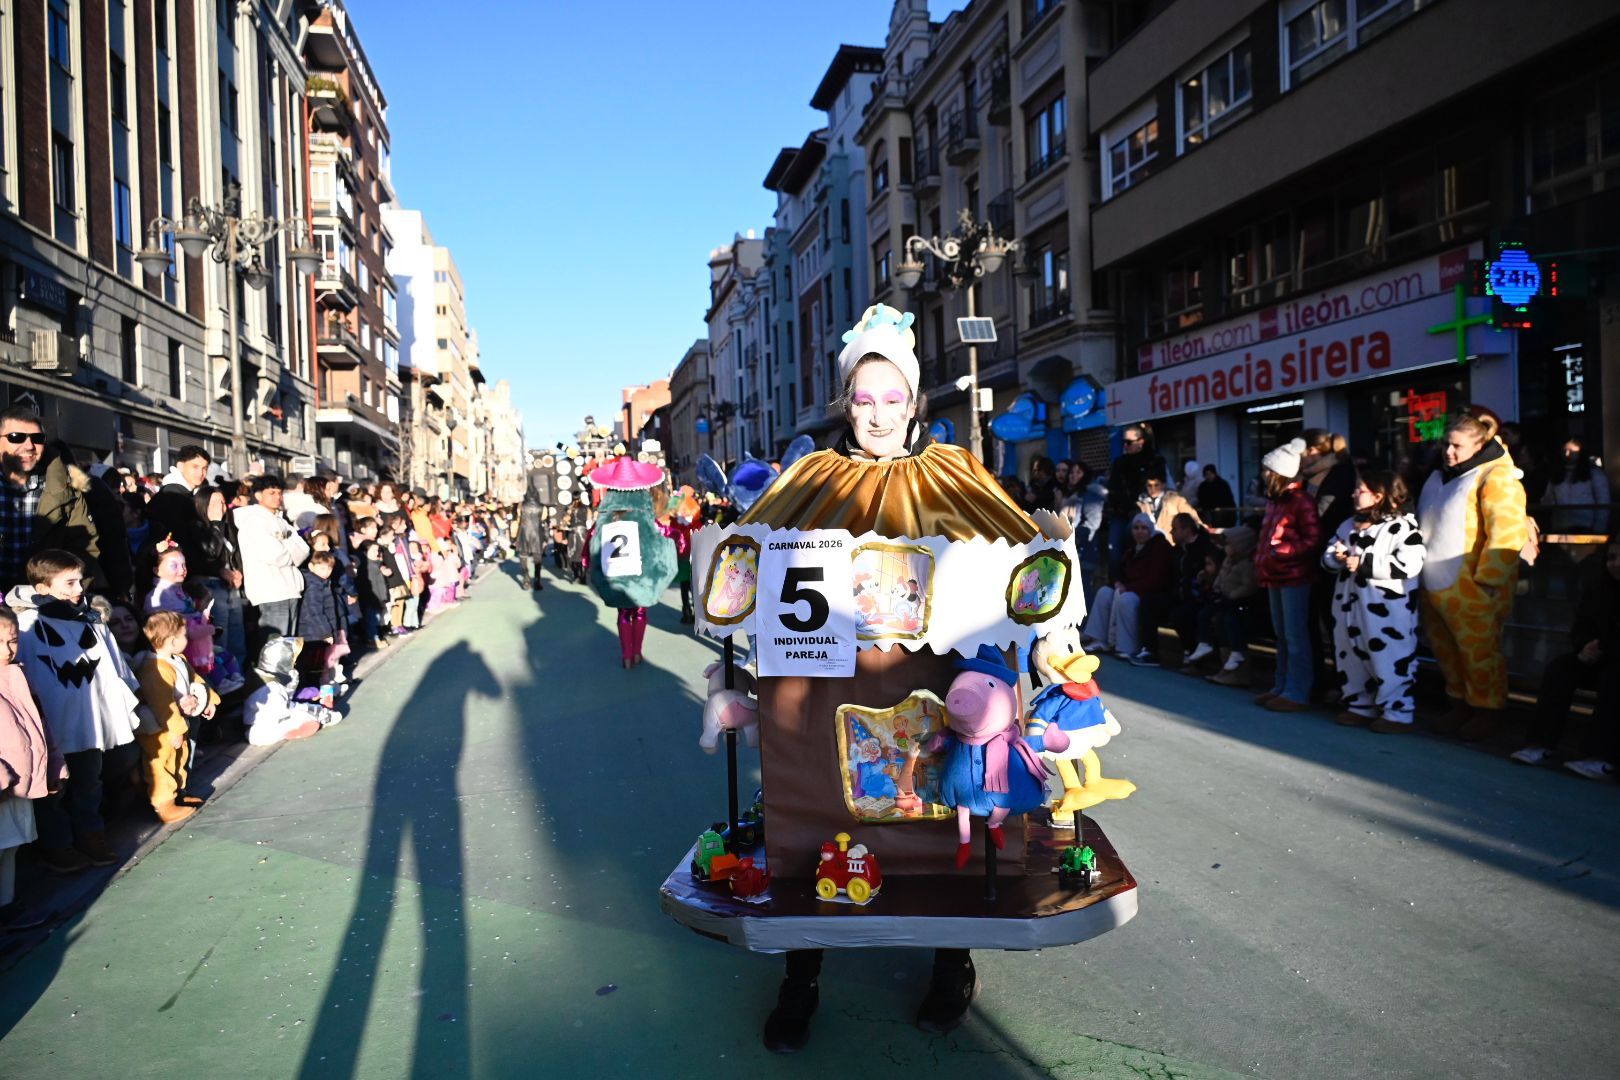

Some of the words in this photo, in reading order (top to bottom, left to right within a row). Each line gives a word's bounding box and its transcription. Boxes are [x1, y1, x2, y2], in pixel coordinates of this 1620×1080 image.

[1495, 268, 1536, 287] 24h
[1286, 271, 1424, 332] ileón.com
[1161, 323, 1254, 365] ileón.com
[1148, 352, 1272, 413] farmacia
[1281, 330, 1391, 388] sirera
[610, 534, 629, 559] 2
[768, 541, 817, 551] CARNAVAL
[819, 540, 843, 549] 2026
[778, 566, 830, 633] 5
[774, 636, 838, 646] INDIVIDUAL
[785, 650, 828, 660] PAREJA
